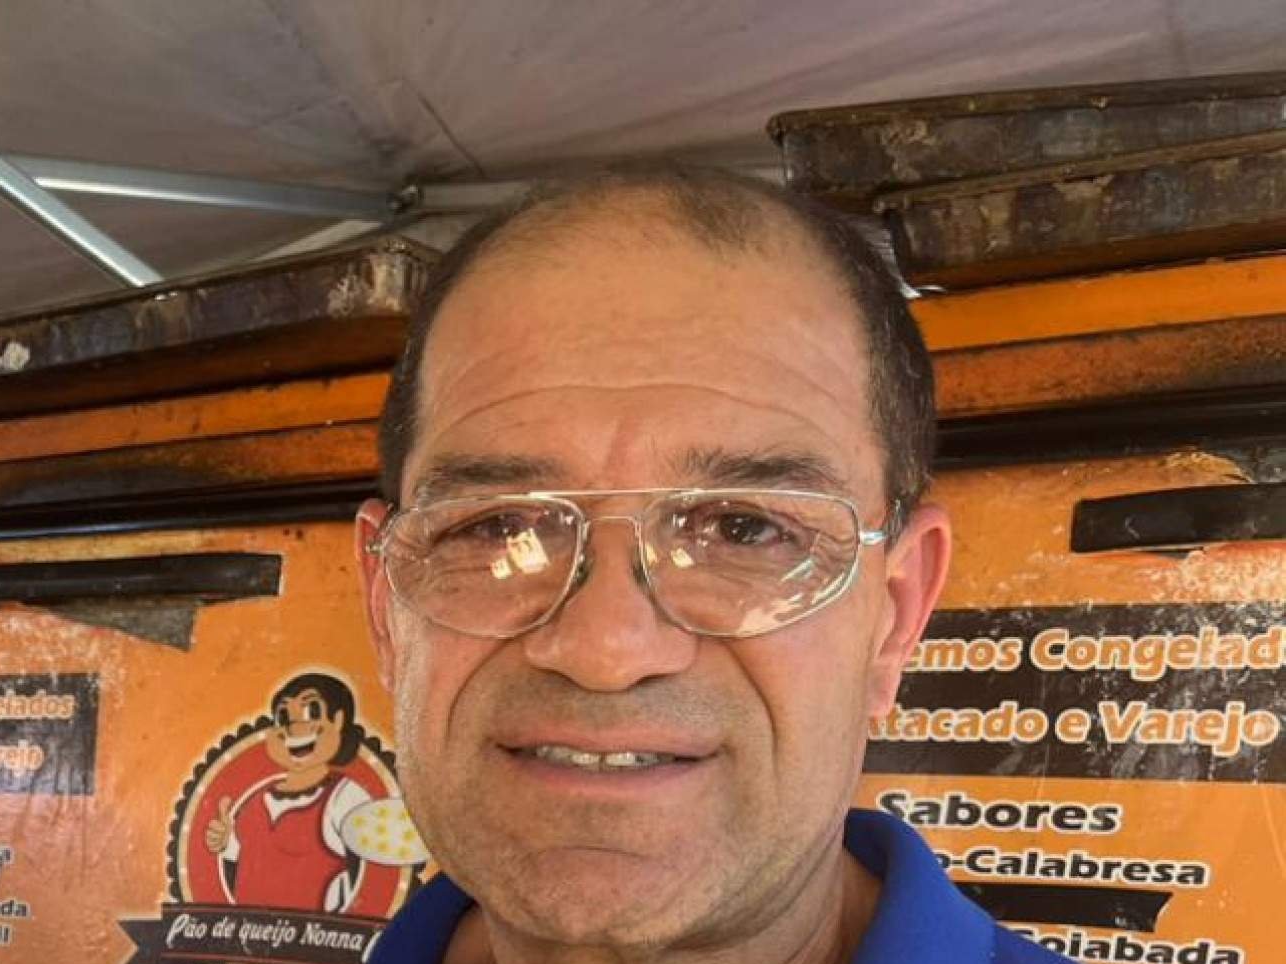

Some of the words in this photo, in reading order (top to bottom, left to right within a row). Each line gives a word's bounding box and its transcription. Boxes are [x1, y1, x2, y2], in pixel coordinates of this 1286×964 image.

[1031, 628, 1286, 682] Congelad
[1055, 708, 1091, 743] e
[1099, 701, 1279, 757] Varejo
[876, 790, 1122, 833] Sabores
[934, 846, 1208, 887] o-Calabresa
[166, 913, 205, 949] Pão
[212, 916, 235, 938] de
[238, 918, 297, 955] queijo
[299, 922, 364, 950] Nonna
